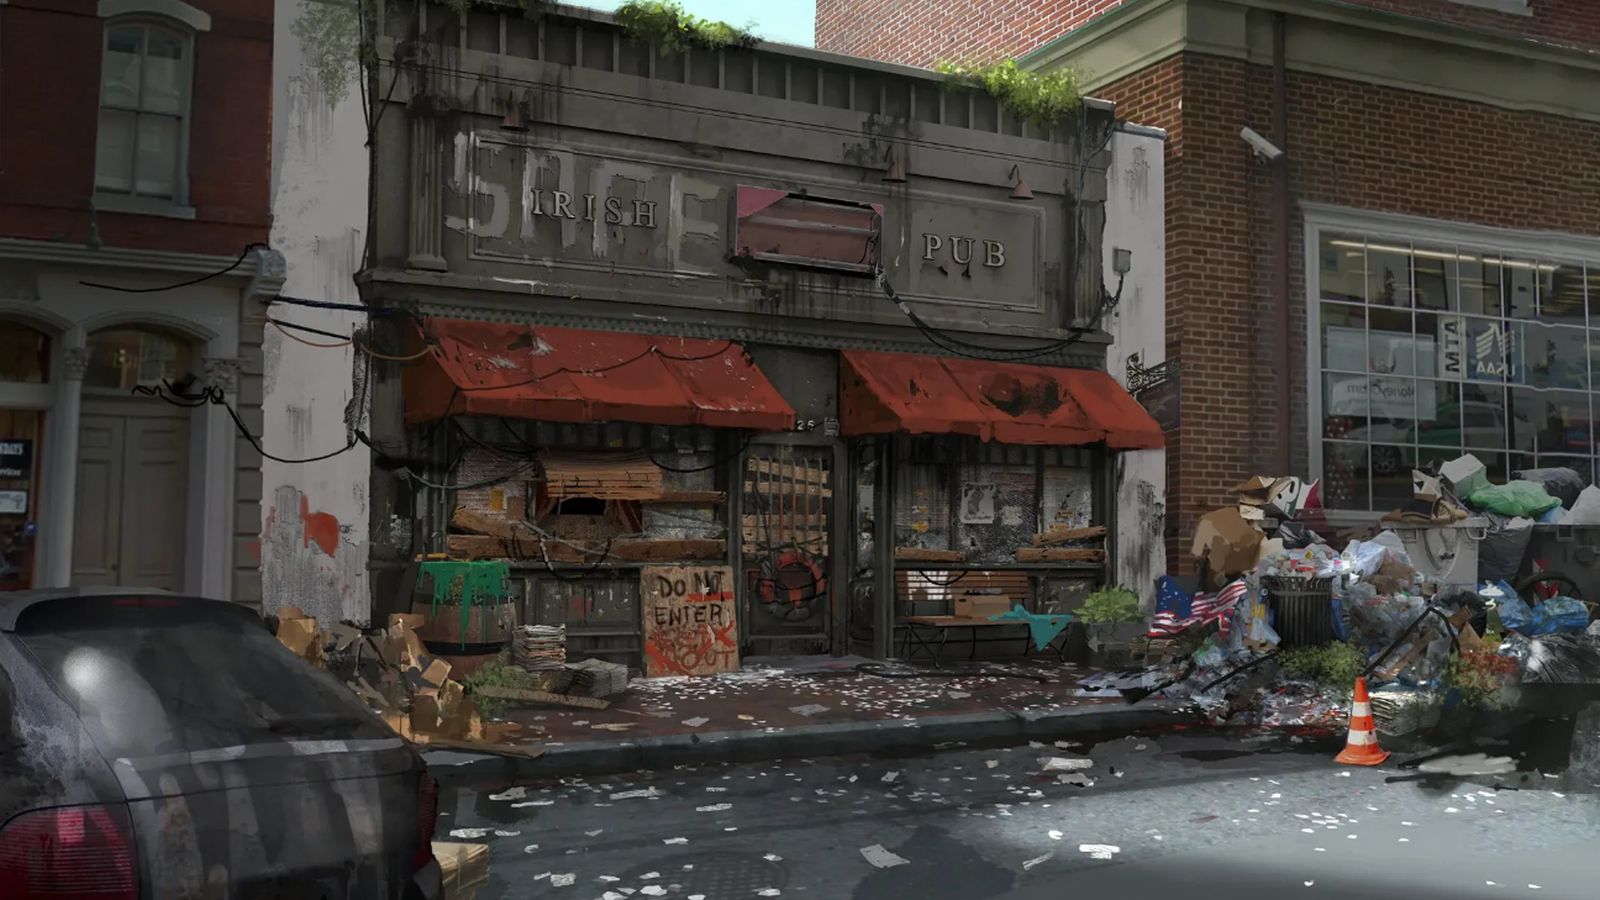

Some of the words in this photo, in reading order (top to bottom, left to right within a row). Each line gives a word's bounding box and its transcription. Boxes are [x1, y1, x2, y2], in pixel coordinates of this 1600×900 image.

[530, 187, 658, 229] IRISH
[922, 232, 1007, 269] PUB
[657, 575, 687, 598] DO
[693, 571, 725, 601] NOT
[655, 603, 723, 627] ENTER
